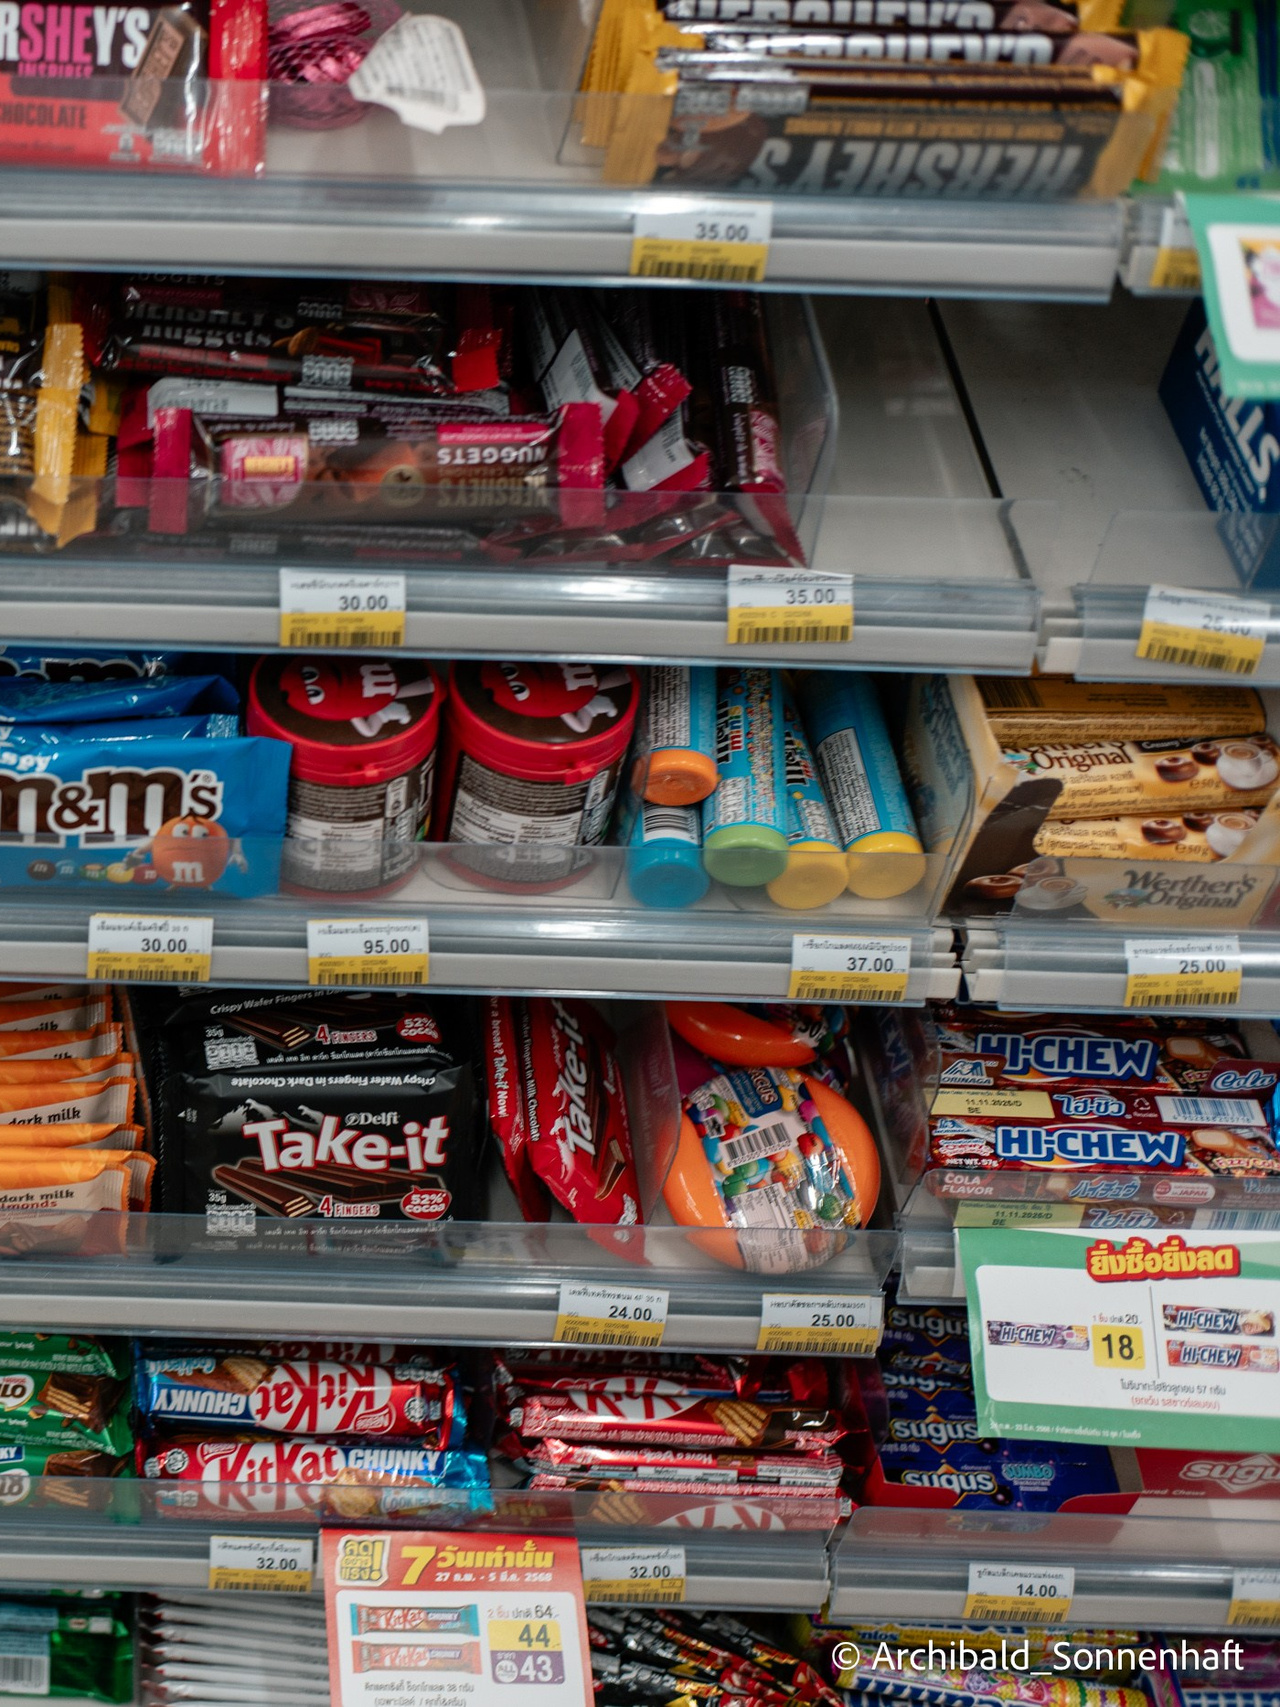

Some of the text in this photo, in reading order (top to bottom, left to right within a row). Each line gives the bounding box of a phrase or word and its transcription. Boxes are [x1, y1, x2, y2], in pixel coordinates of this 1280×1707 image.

[750, 136, 1083, 198] HERSHEY'S
[695, 222, 749, 242] 35.00
[141, 323, 273, 347] nuggets
[436, 446, 548, 465] NUGGETS
[338, 596, 389, 611] 30.00
[786, 589, 836, 604] 35.00
[1201, 613, 1251, 636] 25.00
[1030, 746, 1134, 773] Original
[1123, 868, 1257, 894] Werther's
[1145, 888, 1243, 910] Original
[141, 938, 187, 953] 30.00
[363, 938, 410, 954] 95.00
[847, 957, 894, 972] 37.00
[1179, 959, 1226, 974] 25.00
[210, 1003, 242, 1016] Crispy
[243, 997, 274, 1010] Wafer
[274, 991, 313, 1006] Fingers
[315, 1024, 377, 1045] 4 FINGERS
[400, 1017, 439, 1040] 52% cocoa
[973, 1033, 1160, 1082] HI-CHEW
[230, 1074, 436, 1087] Crispy Wafer Fingers in Dark Chocolate
[551, 998, 597, 1156] Take-it
[1211, 1069, 1277, 1092] Cola
[7, 1106, 81, 1126] dark milk
[359, 1112, 399, 1126] Delfi
[242, 1114, 451, 1173] Take-it
[996, 1125, 1186, 1168] HI-CHEW
[941, 1184, 994, 1195] FLAVOR
[943, 1173, 981, 1185] COLA
[39, 1187, 74, 1200] milk
[404, 1193, 446, 1214] 52% cocoa
[318, 1195, 380, 1217] 4 FINGERS
[608, 1304, 652, 1321] 24.00
[811, 1314, 855, 1328] 25.00
[1177, 1309, 1240, 1332] HI-CHEW
[1000, 1325, 1056, 1345] HI-CHEW
[1180, 1345, 1243, 1367] HI-CHEW
[153, 1387, 248, 1417] CHUNKY
[255, 1361, 376, 1434] KitKat
[889, 1417, 981, 1445] sugus
[348, 1448, 441, 1472] CHUNKY
[216, 1442, 339, 1513] KitKat
[1002, 1463, 1056, 1482] JUMBO
[256, 1557, 298, 1572] 32.00
[401, 1539, 555, 1585] 7 วันเท่านั้น
[629, 1565, 671, 1579] 32.00
[1016, 1583, 1058, 1598] 14.00
[427, 1612, 459, 1621] CHUNKY
